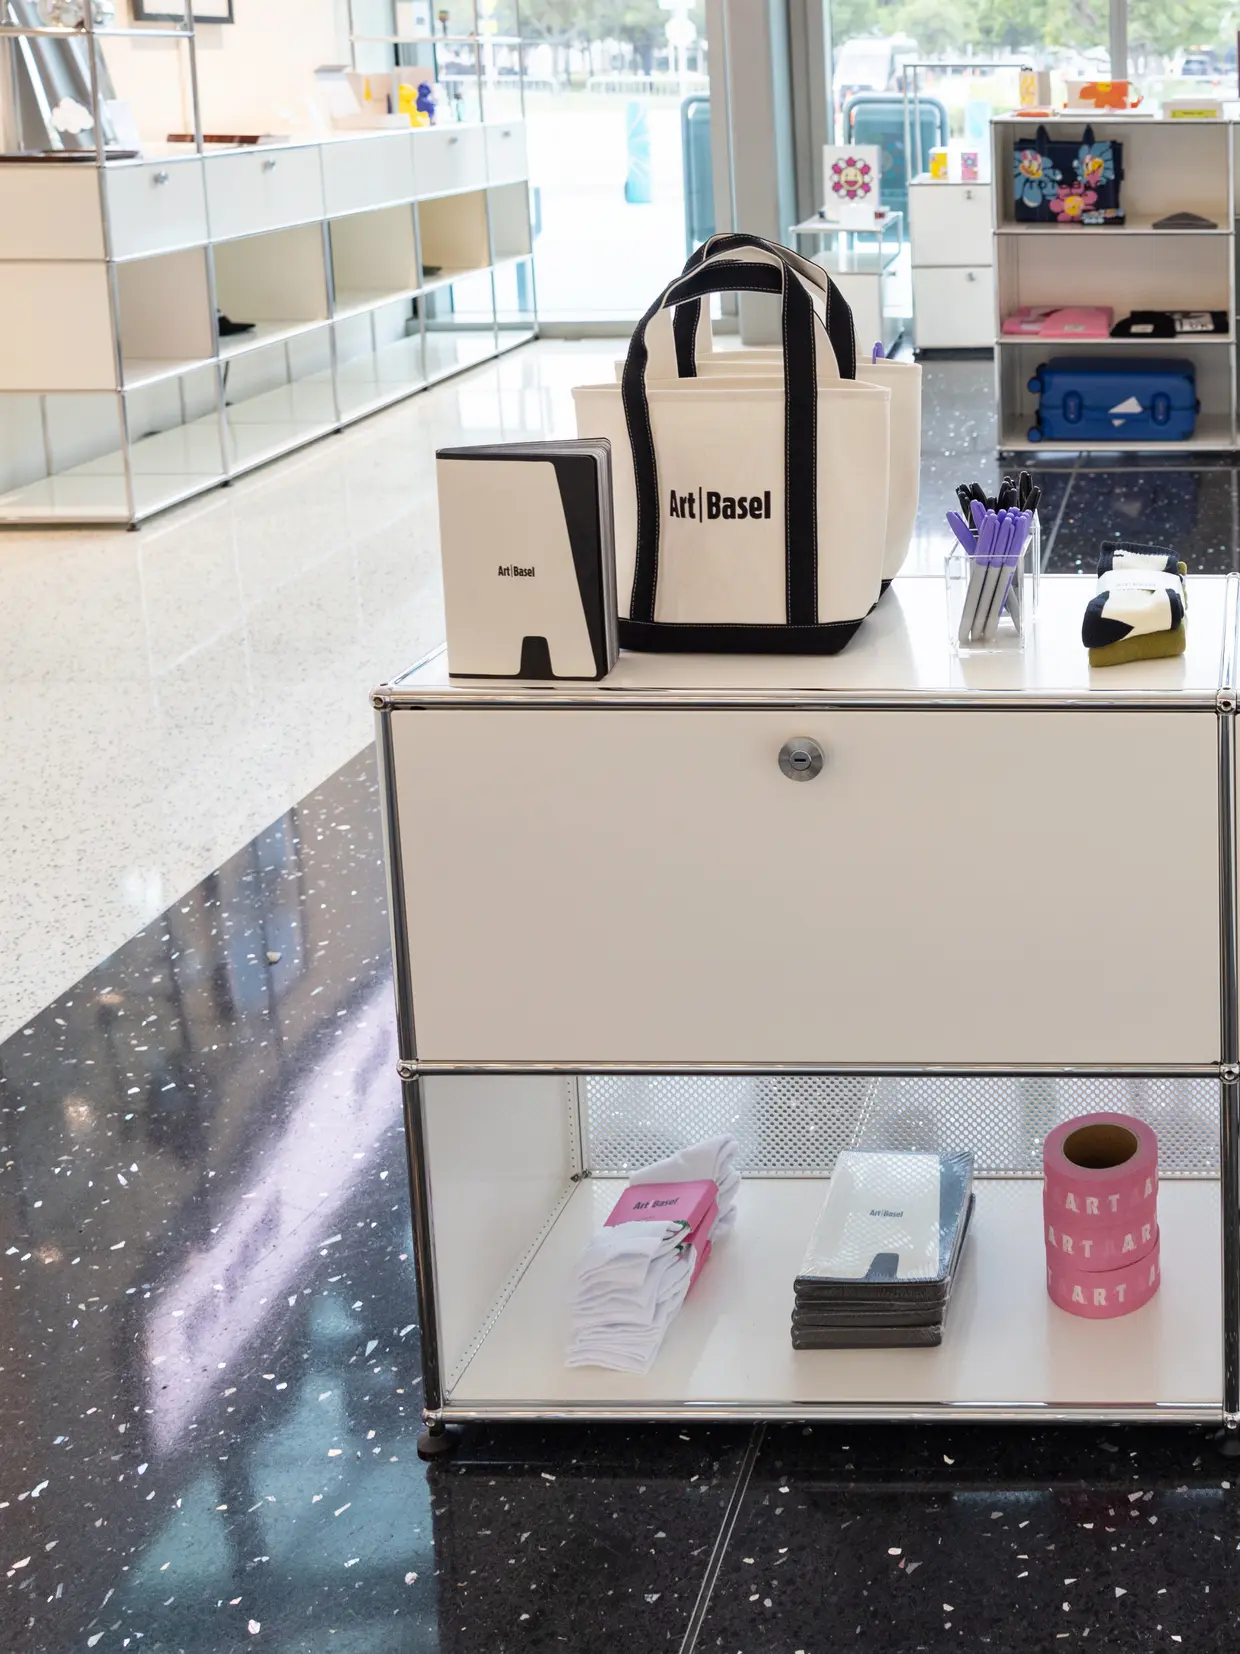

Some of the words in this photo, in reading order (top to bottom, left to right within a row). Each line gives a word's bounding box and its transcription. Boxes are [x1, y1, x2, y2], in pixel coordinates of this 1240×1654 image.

[669, 489, 696, 519] Art
[706, 490, 771, 520] Basel
[498, 565, 510, 577] Art
[513, 565, 535, 578] Basel
[633, 1201, 648, 1210] Art
[652, 1196, 680, 1208] Basel
[1065, 1192, 1120, 1216] ART
[1071, 1283, 1127, 1306] ART
